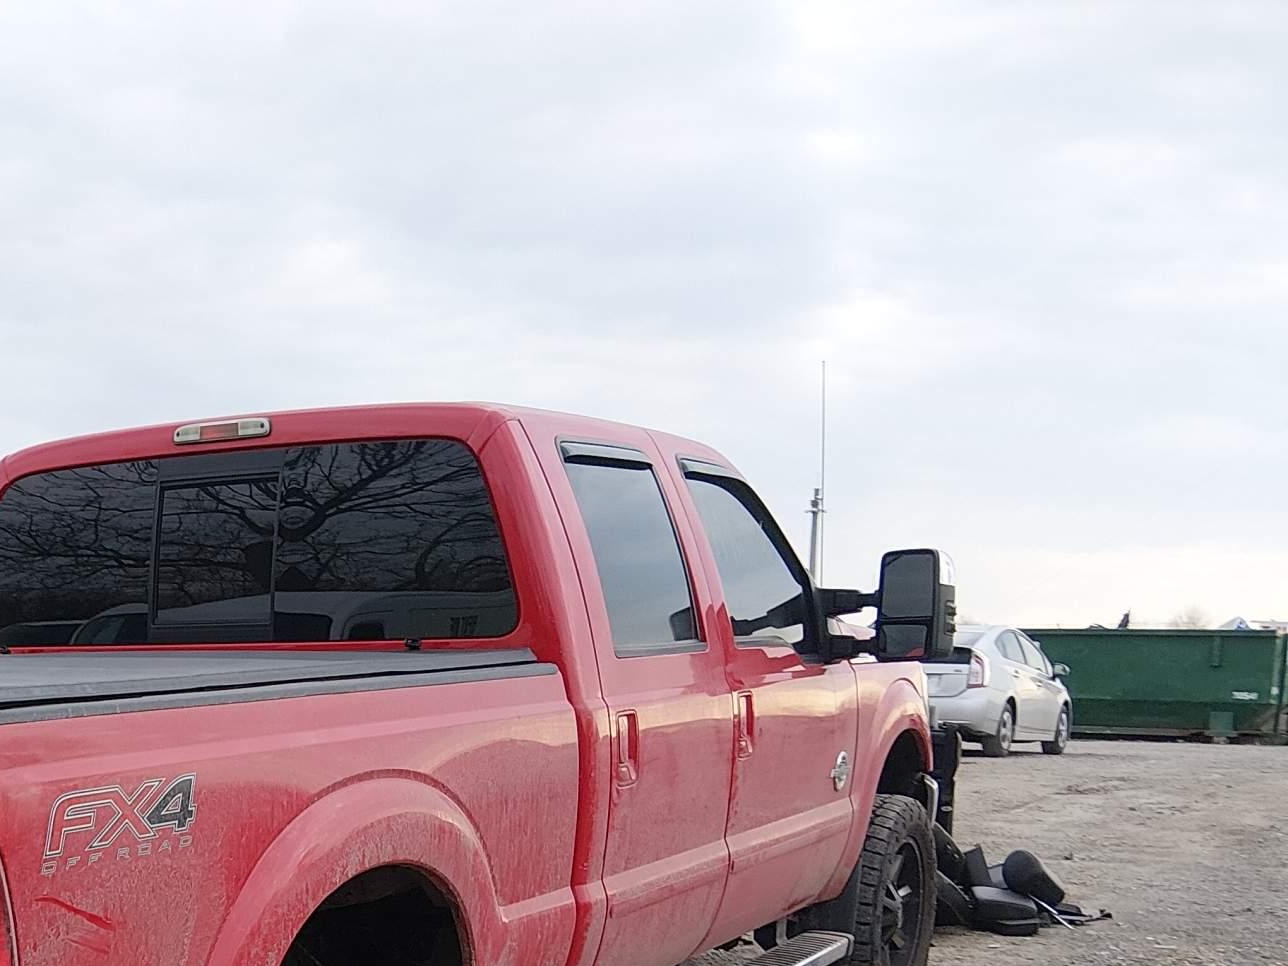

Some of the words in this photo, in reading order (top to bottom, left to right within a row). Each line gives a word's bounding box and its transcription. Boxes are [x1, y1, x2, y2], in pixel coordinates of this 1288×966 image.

[42, 772, 197, 859] FX4
[40, 852, 103, 876] OFF
[116, 835, 194, 861] ROAD
